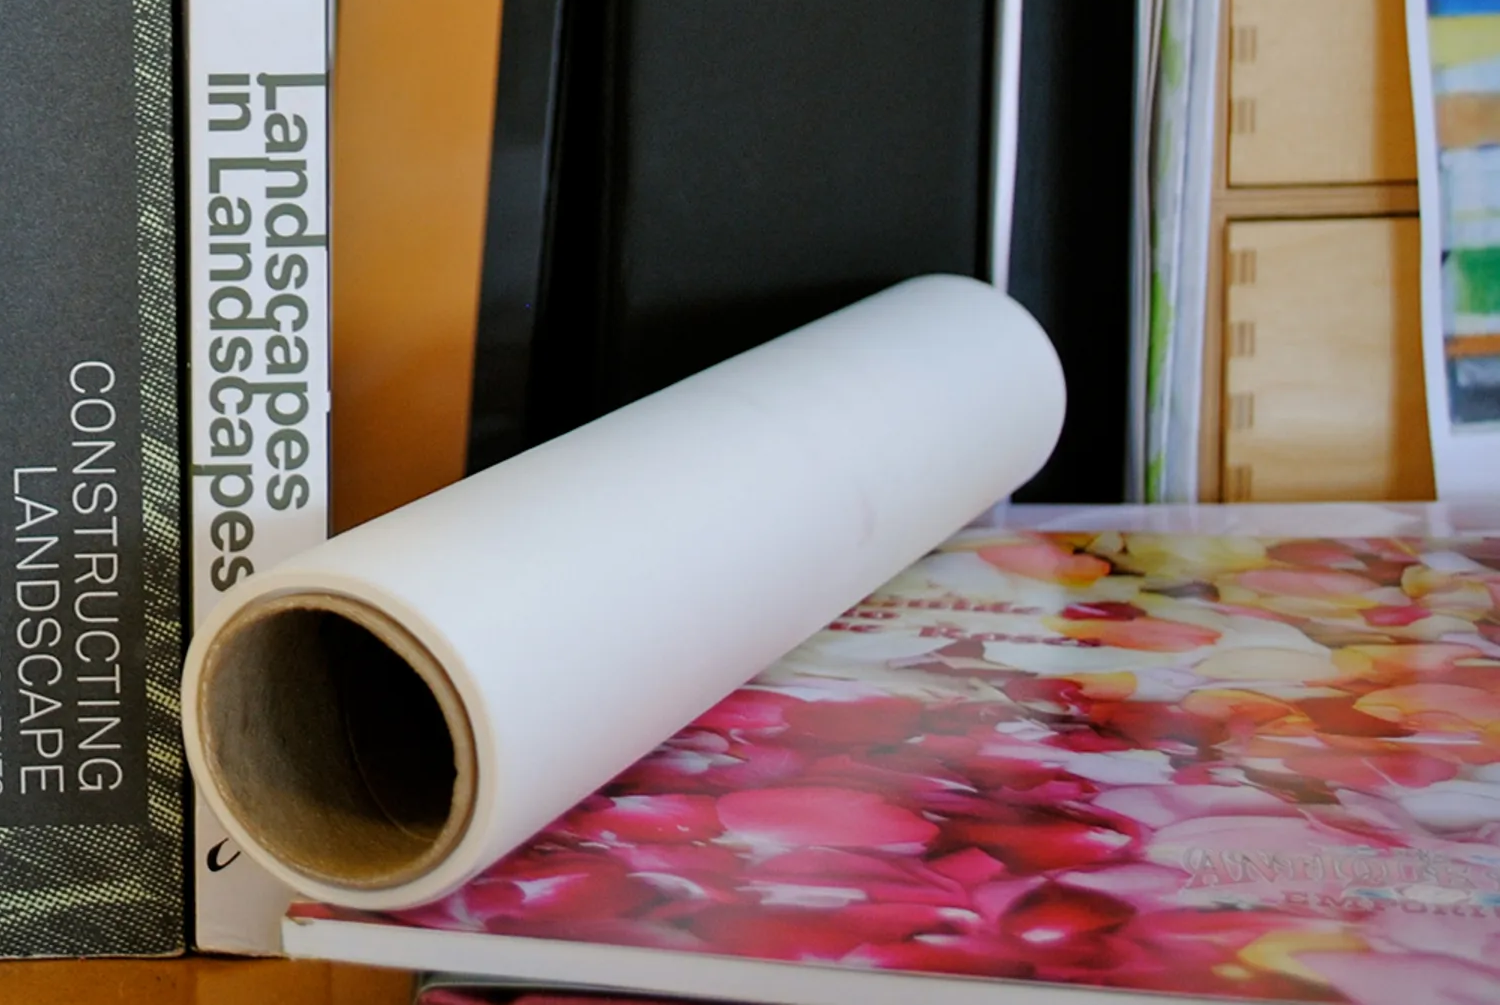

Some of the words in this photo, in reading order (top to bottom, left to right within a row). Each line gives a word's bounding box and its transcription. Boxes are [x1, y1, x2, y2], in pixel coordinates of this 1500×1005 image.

[208, 72, 265, 132] in
[252, 72, 327, 511] Landscapes
[69, 360, 123, 794] CONSTRUCTING
[193, 157, 267, 592] Landscapes
[14, 465, 64, 796] LANDSCAPE
